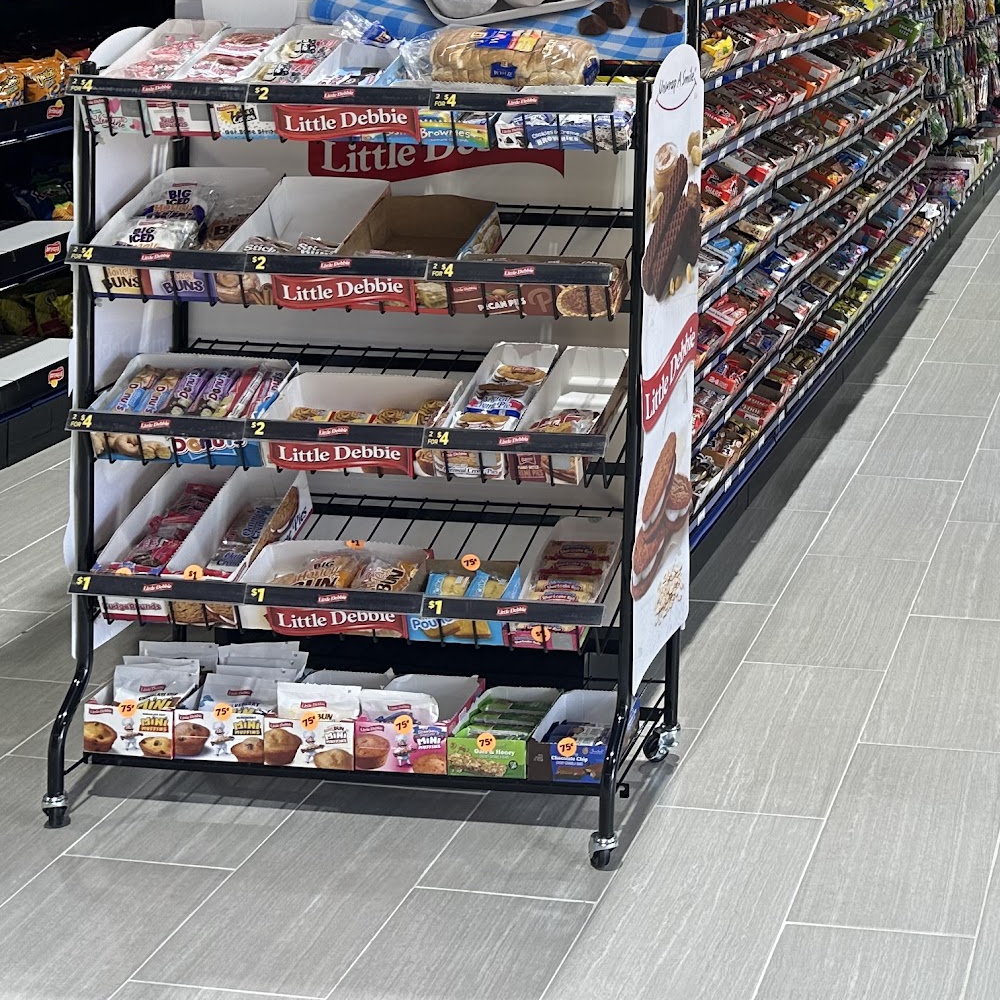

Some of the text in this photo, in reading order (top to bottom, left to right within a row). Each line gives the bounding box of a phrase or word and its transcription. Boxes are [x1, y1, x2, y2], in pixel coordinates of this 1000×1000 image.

[80, 79, 94, 93] $4
[254, 86, 270, 100] $2
[444, 93, 457, 107] $4
[284, 108, 408, 132] Little Debbie
[321, 141, 416, 173] Little
[168, 189, 192, 200] BIG
[133, 226, 156, 235] BIG
[129, 234, 155, 243] ICED
[81, 247, 94, 260] $4
[252, 256, 267, 270] $2
[441, 263, 454, 277] $4
[282, 277, 404, 301] Little Debbie
[478, 300, 507, 311] PCAN
[645, 327, 696, 421] Little Debbie
[80, 414, 93, 428] $4
[251, 422, 265, 436] $2
[437, 432, 449, 446] $4
[278, 444, 401, 462] Little Debbie
[76, 576, 91, 591] $1
[251, 588, 265, 602] $1
[428, 600, 443, 615] $1
[277, 611, 396, 629] Little Debbie
[411, 618, 457, 630] Pou
